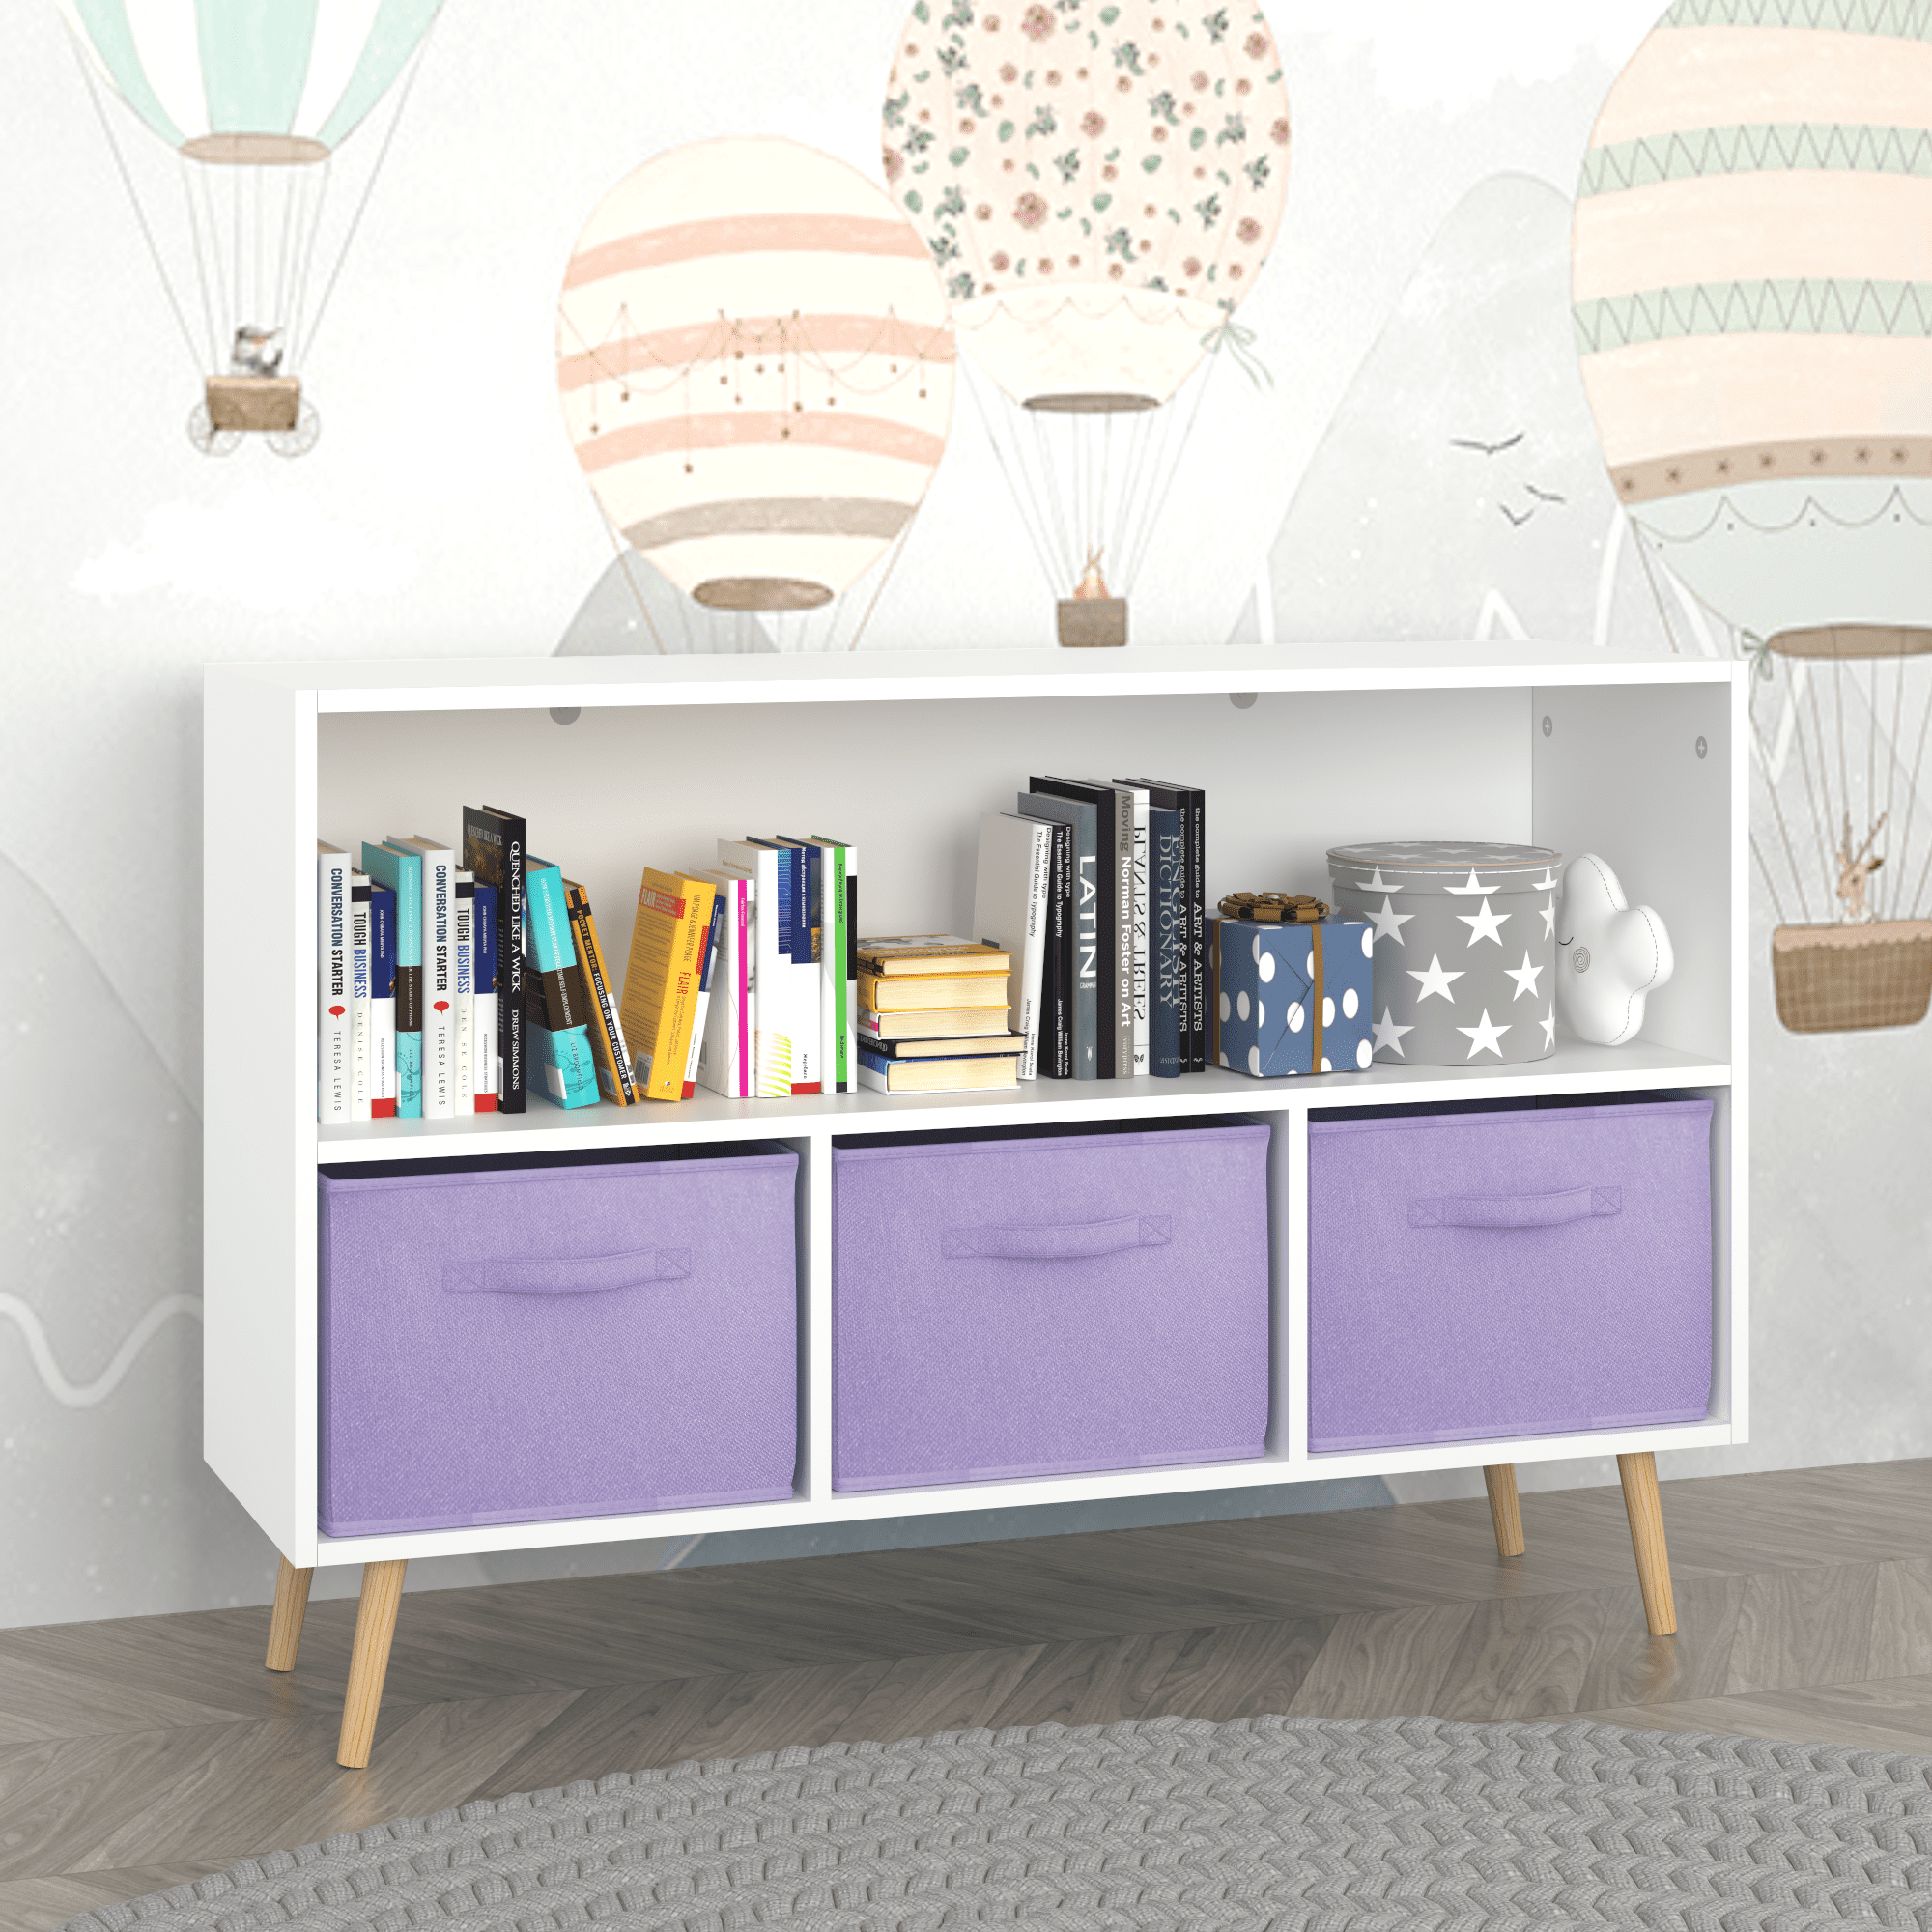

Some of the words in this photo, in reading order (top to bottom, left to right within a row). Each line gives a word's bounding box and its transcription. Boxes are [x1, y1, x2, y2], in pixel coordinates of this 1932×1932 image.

[1120, 796, 1131, 852] Moving
[1043, 827, 1052, 864] Designing
[509, 841, 520, 912] QUENCHED
[1122, 856, 1132, 920] Norman
[1180, 890, 1185, 899] to
[1195, 890, 1200, 898] to
[331, 868, 343, 947] CONVERSATION
[436, 865, 447, 942] CONVERSATION
[1029, 901, 1038, 937] Typography
[1079, 855, 1096, 978] LATIN
[1159, 834, 1172, 1009] DICTIONARY
[1193, 901, 1202, 937] ART
[354, 912, 367, 946] TOUGH
[457, 908, 470, 941] TOUGH
[577, 910, 590, 937] POCKET
[512, 943, 520, 953] A
[583, 939, 598, 972] MENTOR:
[1122, 924, 1132, 974] Foster
[1194, 942, 1202, 956] &
[331, 949, 343, 996] STARTER
[354, 949, 367, 999] BUSINESS
[437, 945, 447, 991] STARTER
[458, 945, 470, 994] BUSINESS
[512, 956, 521, 993] WICK
[676, 972, 692, 995] FLAIR
[593, 972, 608, 1009] FOCUSING
[1122, 979, 1130, 998] on
[1193, 958, 1202, 1032] ARTISTS
[603, 1009, 611, 1020] ON
[606, 1021, 617, 1040] YOUR
[1122, 1003, 1132, 1027] Art
[333, 1031, 342, 1071] TERESA
[611, 1041, 628, 1079] CUSTOMER
[333, 1078, 342, 1111] LEWIS
